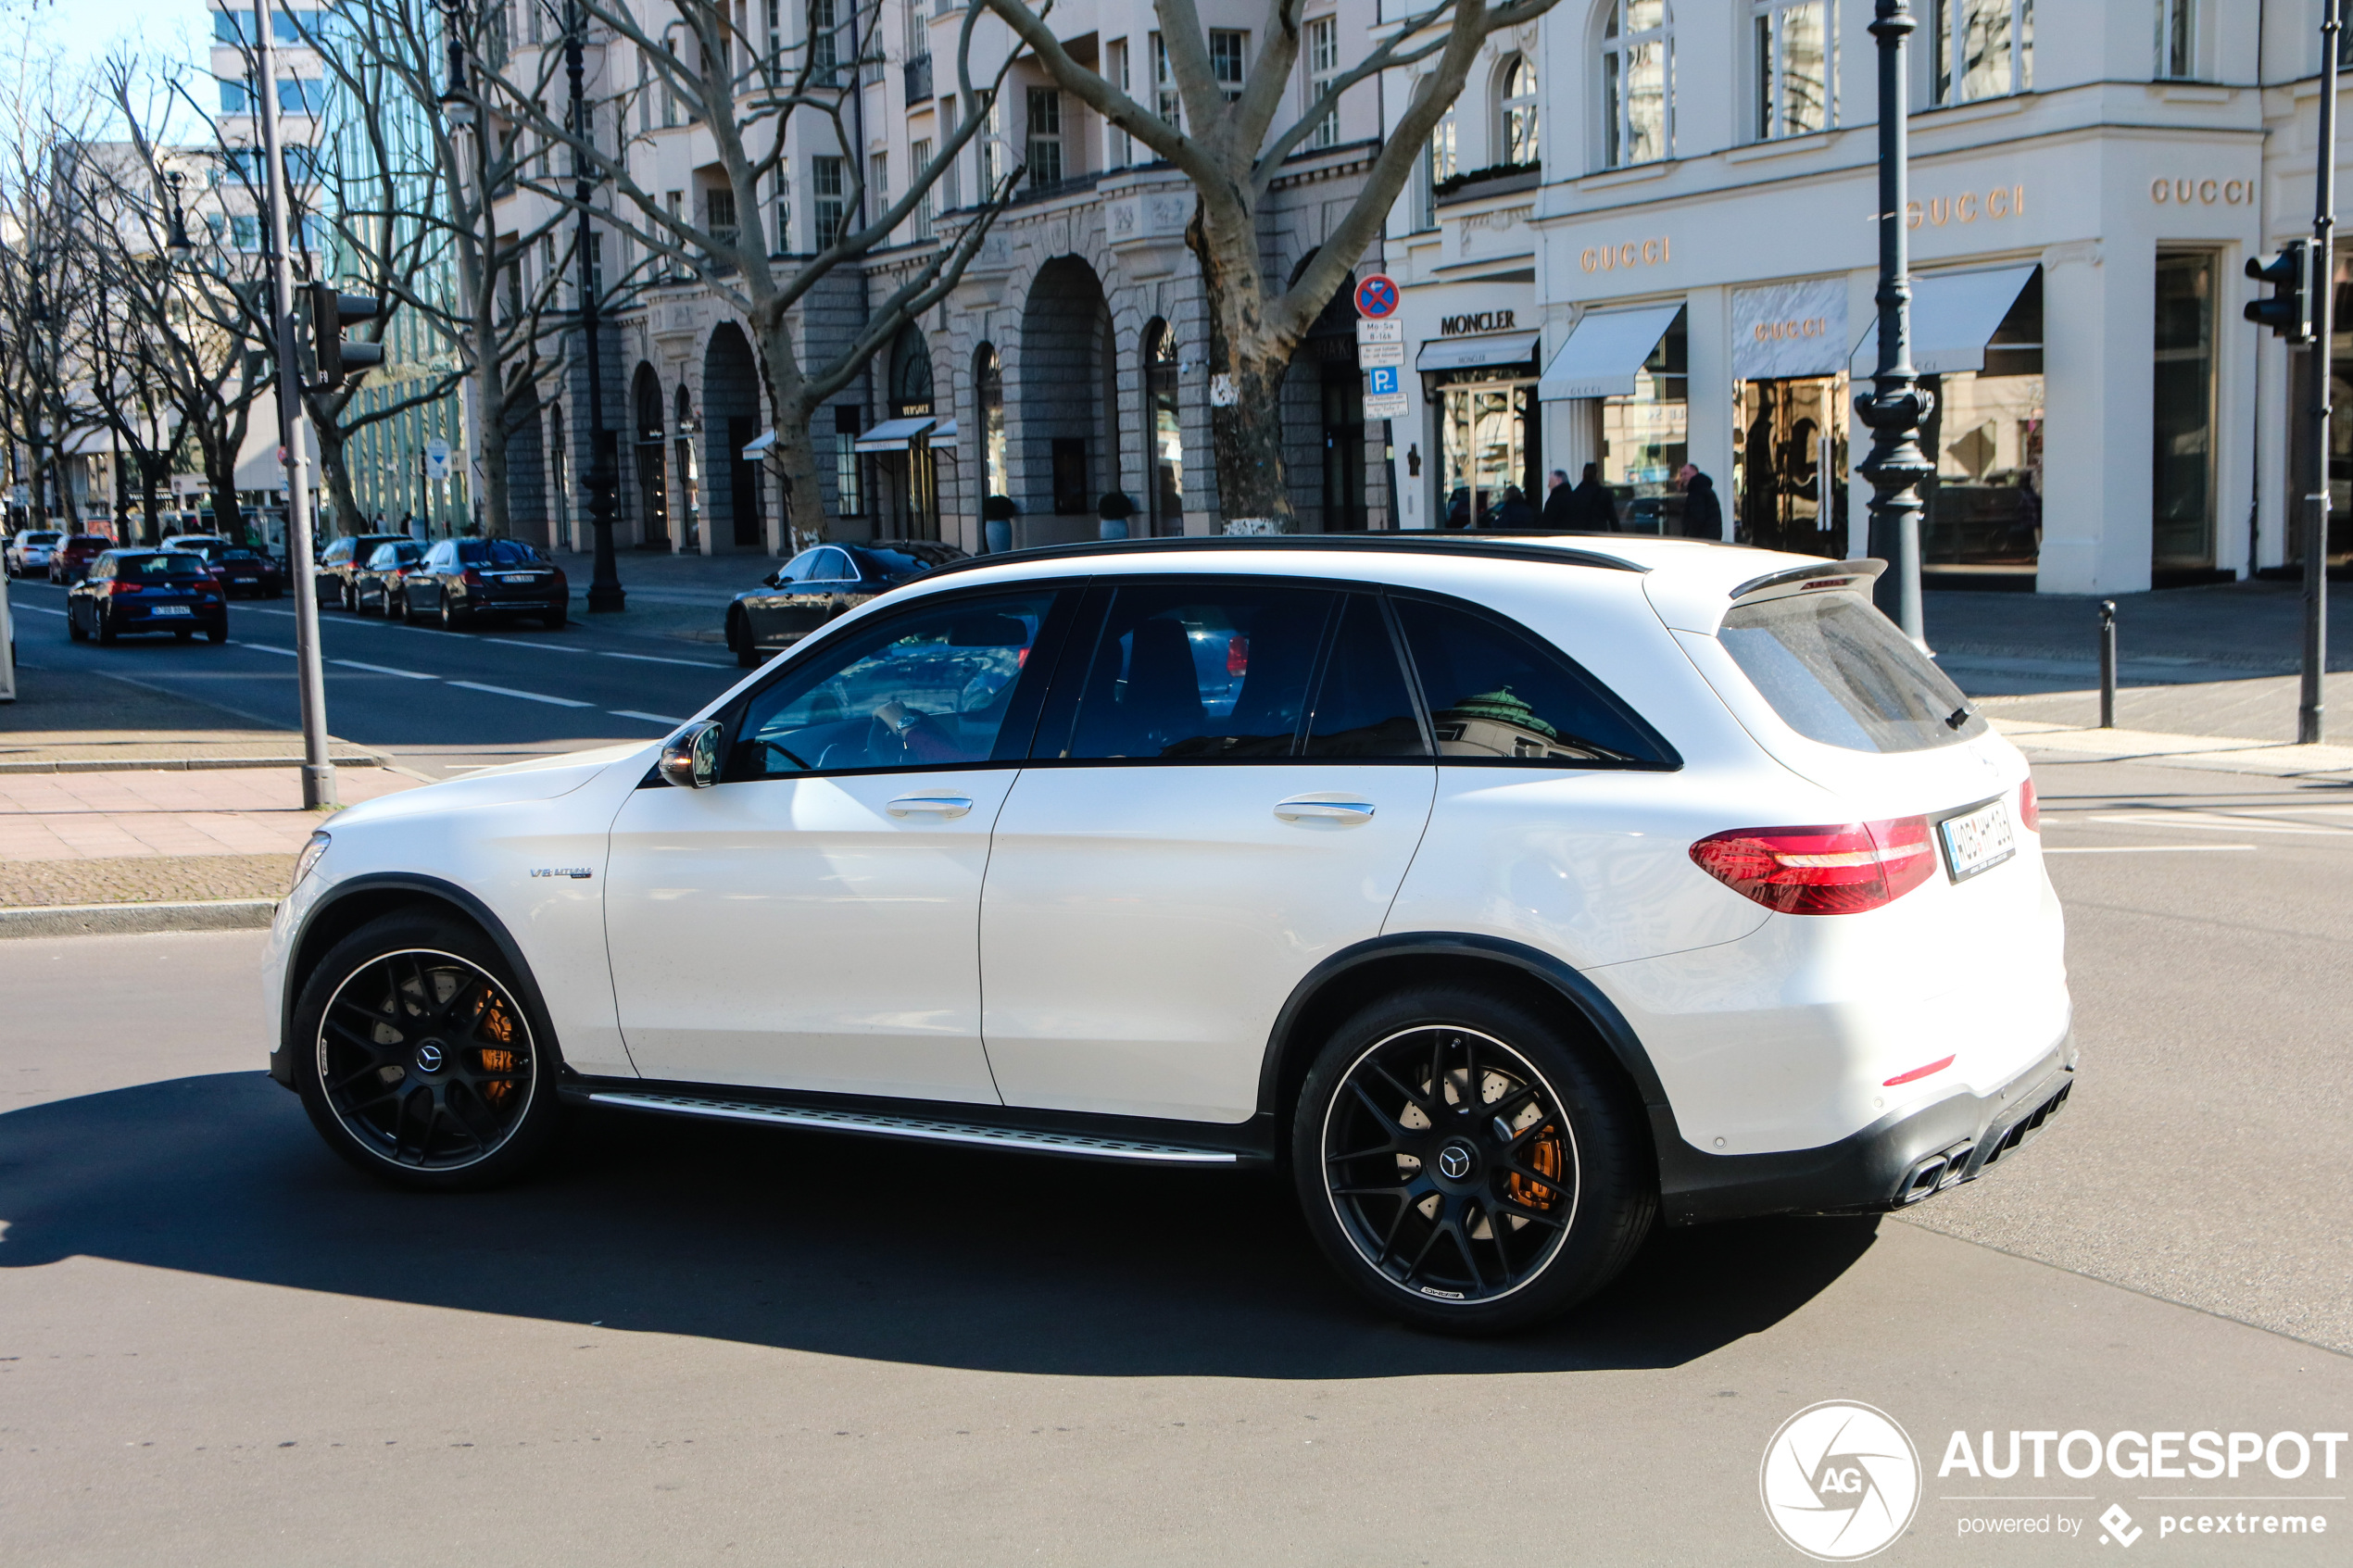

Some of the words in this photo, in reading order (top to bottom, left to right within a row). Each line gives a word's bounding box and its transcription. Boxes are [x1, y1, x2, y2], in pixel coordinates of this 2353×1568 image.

[2151, 179, 2253, 206] GUCCI
[1906, 184, 2024, 230] GUCCI
[1580, 236, 1669, 273] GUCCI
[1441, 308, 1516, 335] MONCLER
[1755, 317, 1826, 343] GUCCI
[1375, 370, 1390, 393] P
[530, 869, 553, 877] V8
